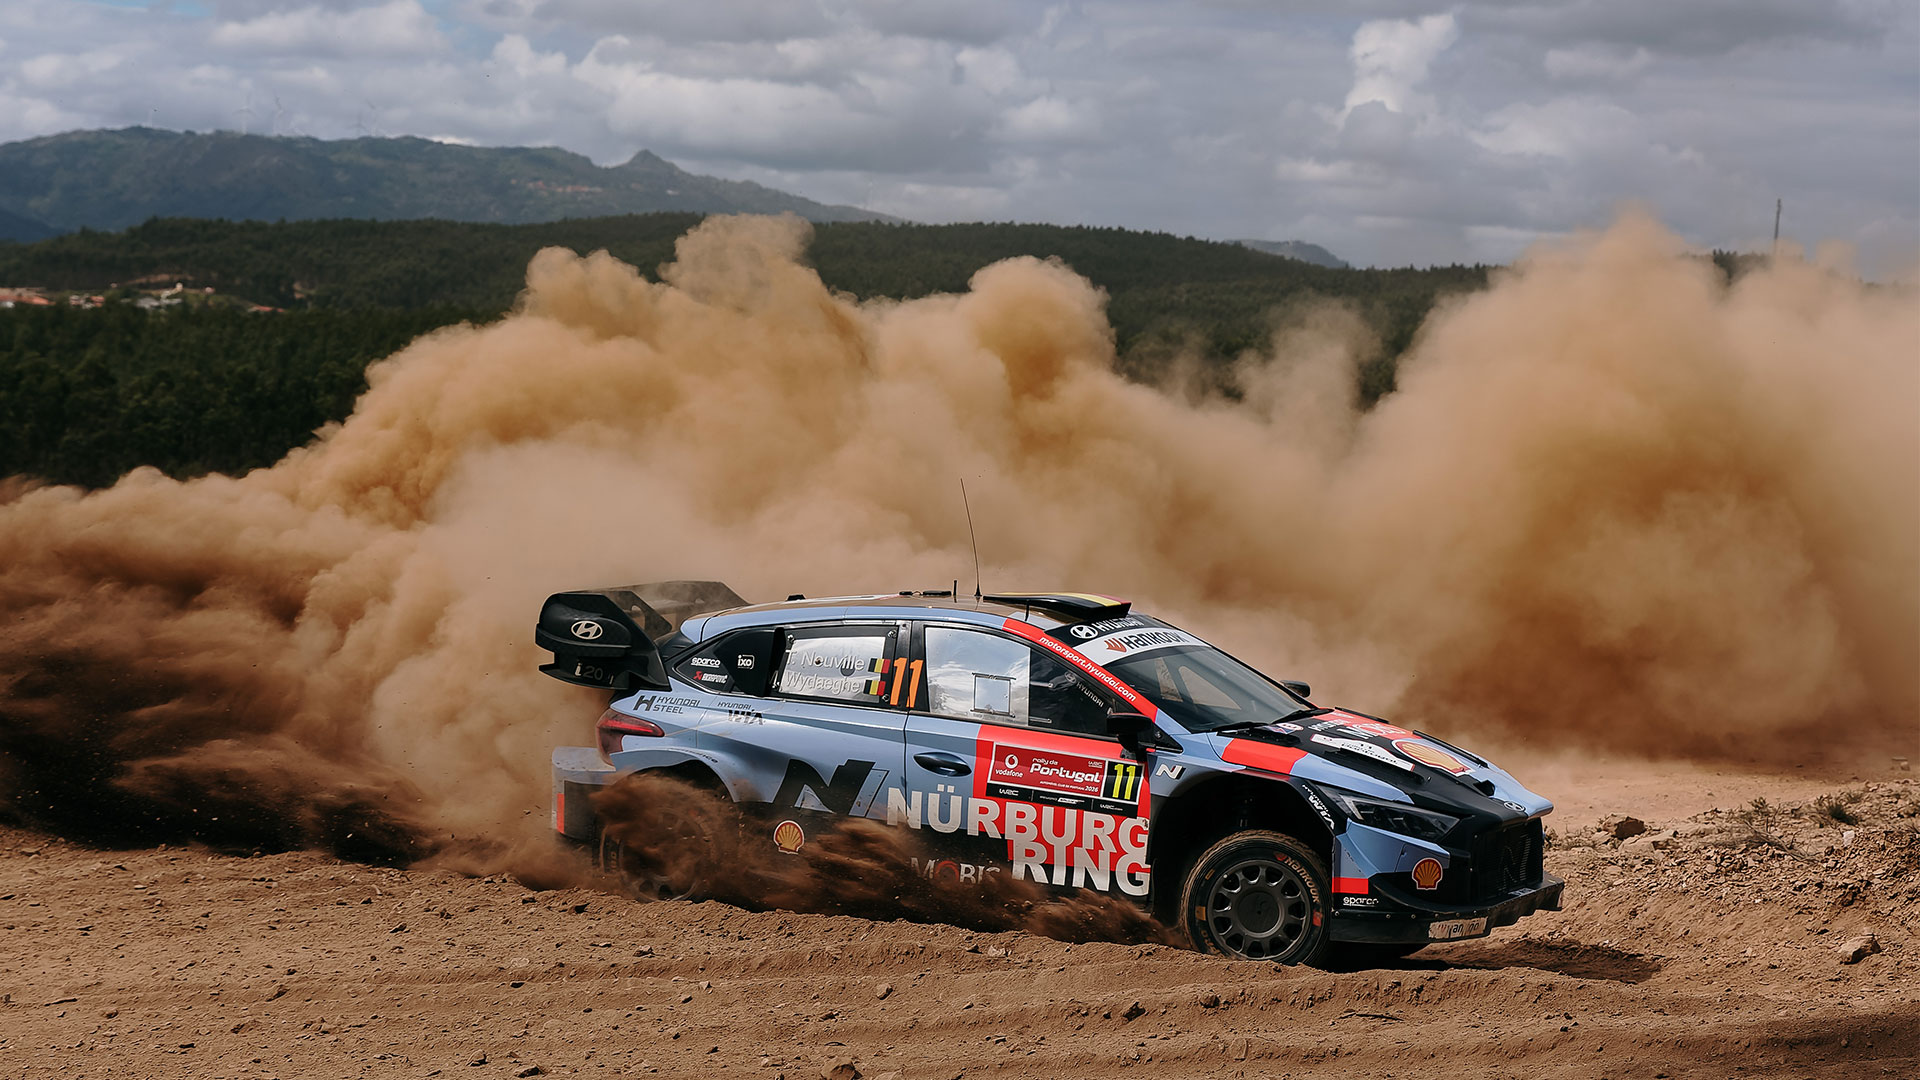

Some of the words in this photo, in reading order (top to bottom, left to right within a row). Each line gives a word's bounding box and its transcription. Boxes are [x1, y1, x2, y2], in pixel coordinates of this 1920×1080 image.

[1092, 616, 1145, 632] HYUNDAI
[691, 657, 721, 668] sparco
[737, 654, 753, 667] ixo
[785, 649, 796, 666] T.
[801, 651, 865, 671] Neuville
[1039, 636, 1137, 702] motorsport.hyundai.com
[786, 670, 861, 694] Wydaeghe
[890, 657, 924, 708] 11
[657, 696, 702, 708] HYUNDAI
[1076, 682, 1105, 708] HYUNDAI
[653, 704, 684, 715] STEEL
[717, 701, 752, 710] HYUNDAI
[1032, 757, 1049, 766] rally
[995, 769, 1024, 778] vodafone
[1030, 762, 1101, 783] Portugal
[1112, 763, 1137, 801] 11
[999, 788, 1019, 797] WRC
[887, 783, 1150, 855] NÜRBURG
[1011, 838, 1151, 897] RING
[1343, 896, 1379, 907] sparco
